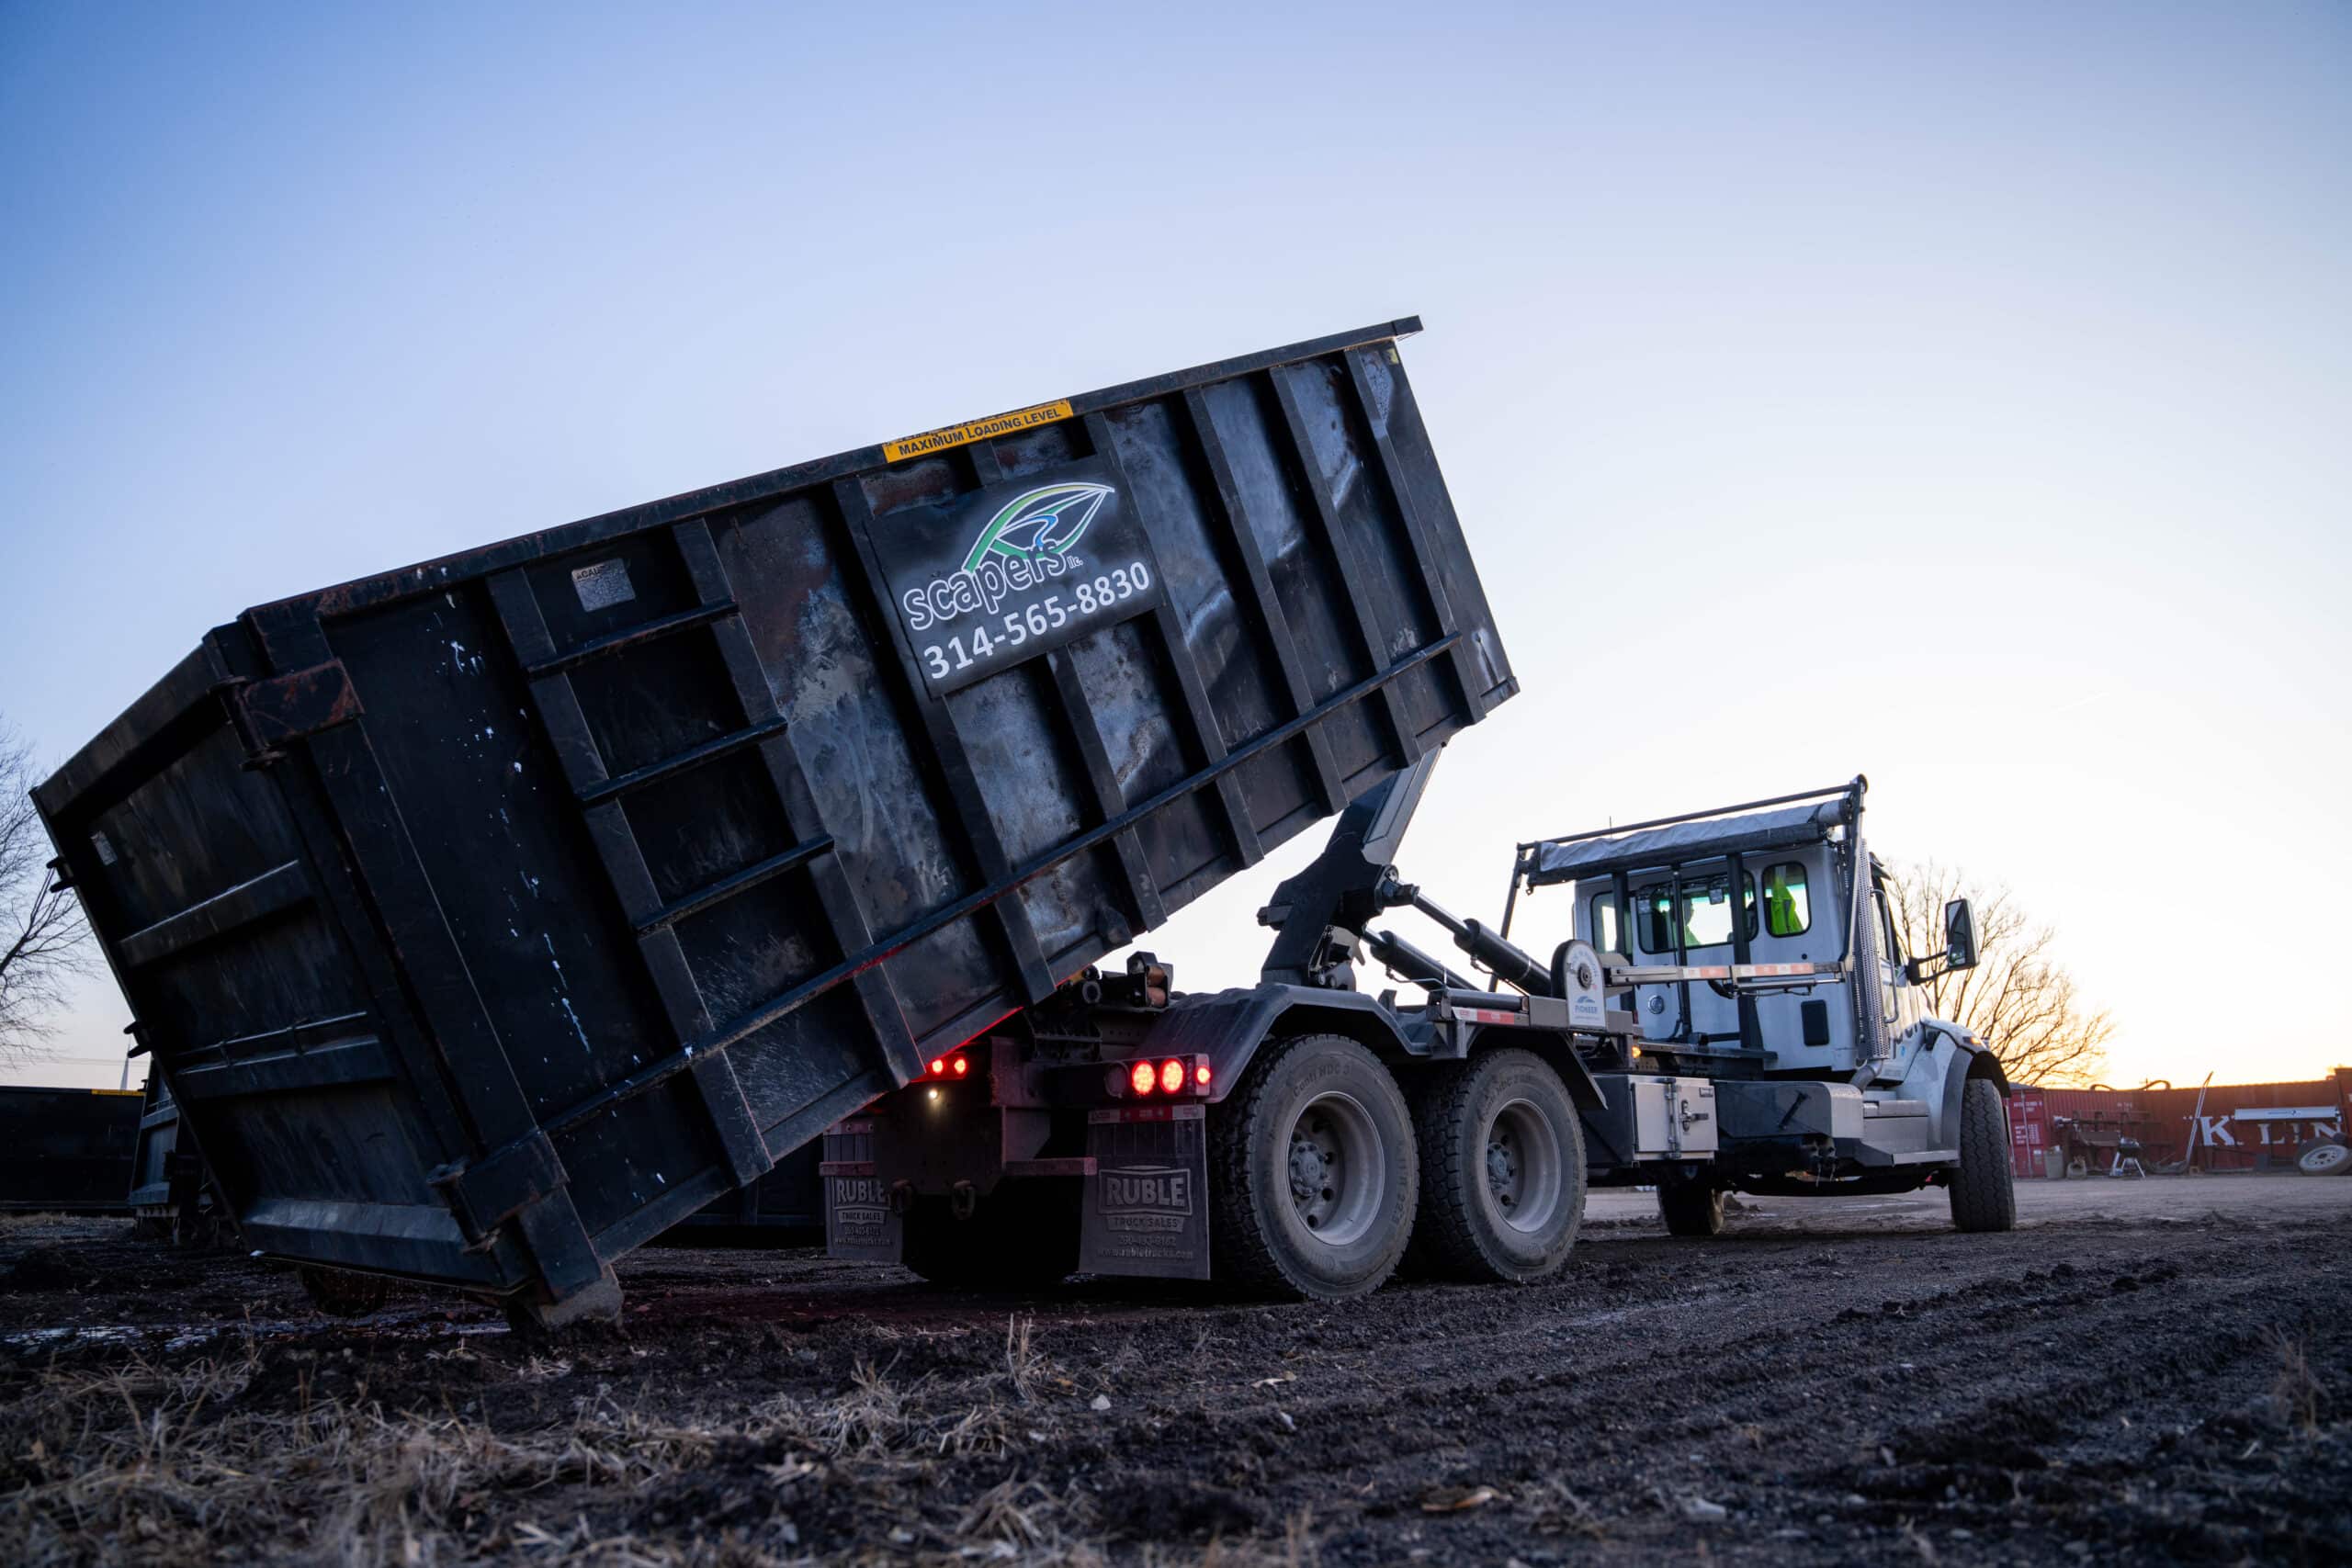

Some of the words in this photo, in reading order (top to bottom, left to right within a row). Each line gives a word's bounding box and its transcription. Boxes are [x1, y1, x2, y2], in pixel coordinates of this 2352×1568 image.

[898, 430, 965, 457] MAXIMUM
[967, 416, 1023, 440] LOADING
[1023, 407, 1061, 429] LEVEL
[903, 539, 1067, 631] scapers
[923, 561, 1150, 680] 314-565-8830
[1105, 1177, 1186, 1208] RUBLE
[1114, 1216, 1147, 1229] TRUCK
[1147, 1217, 1179, 1229] SALES
